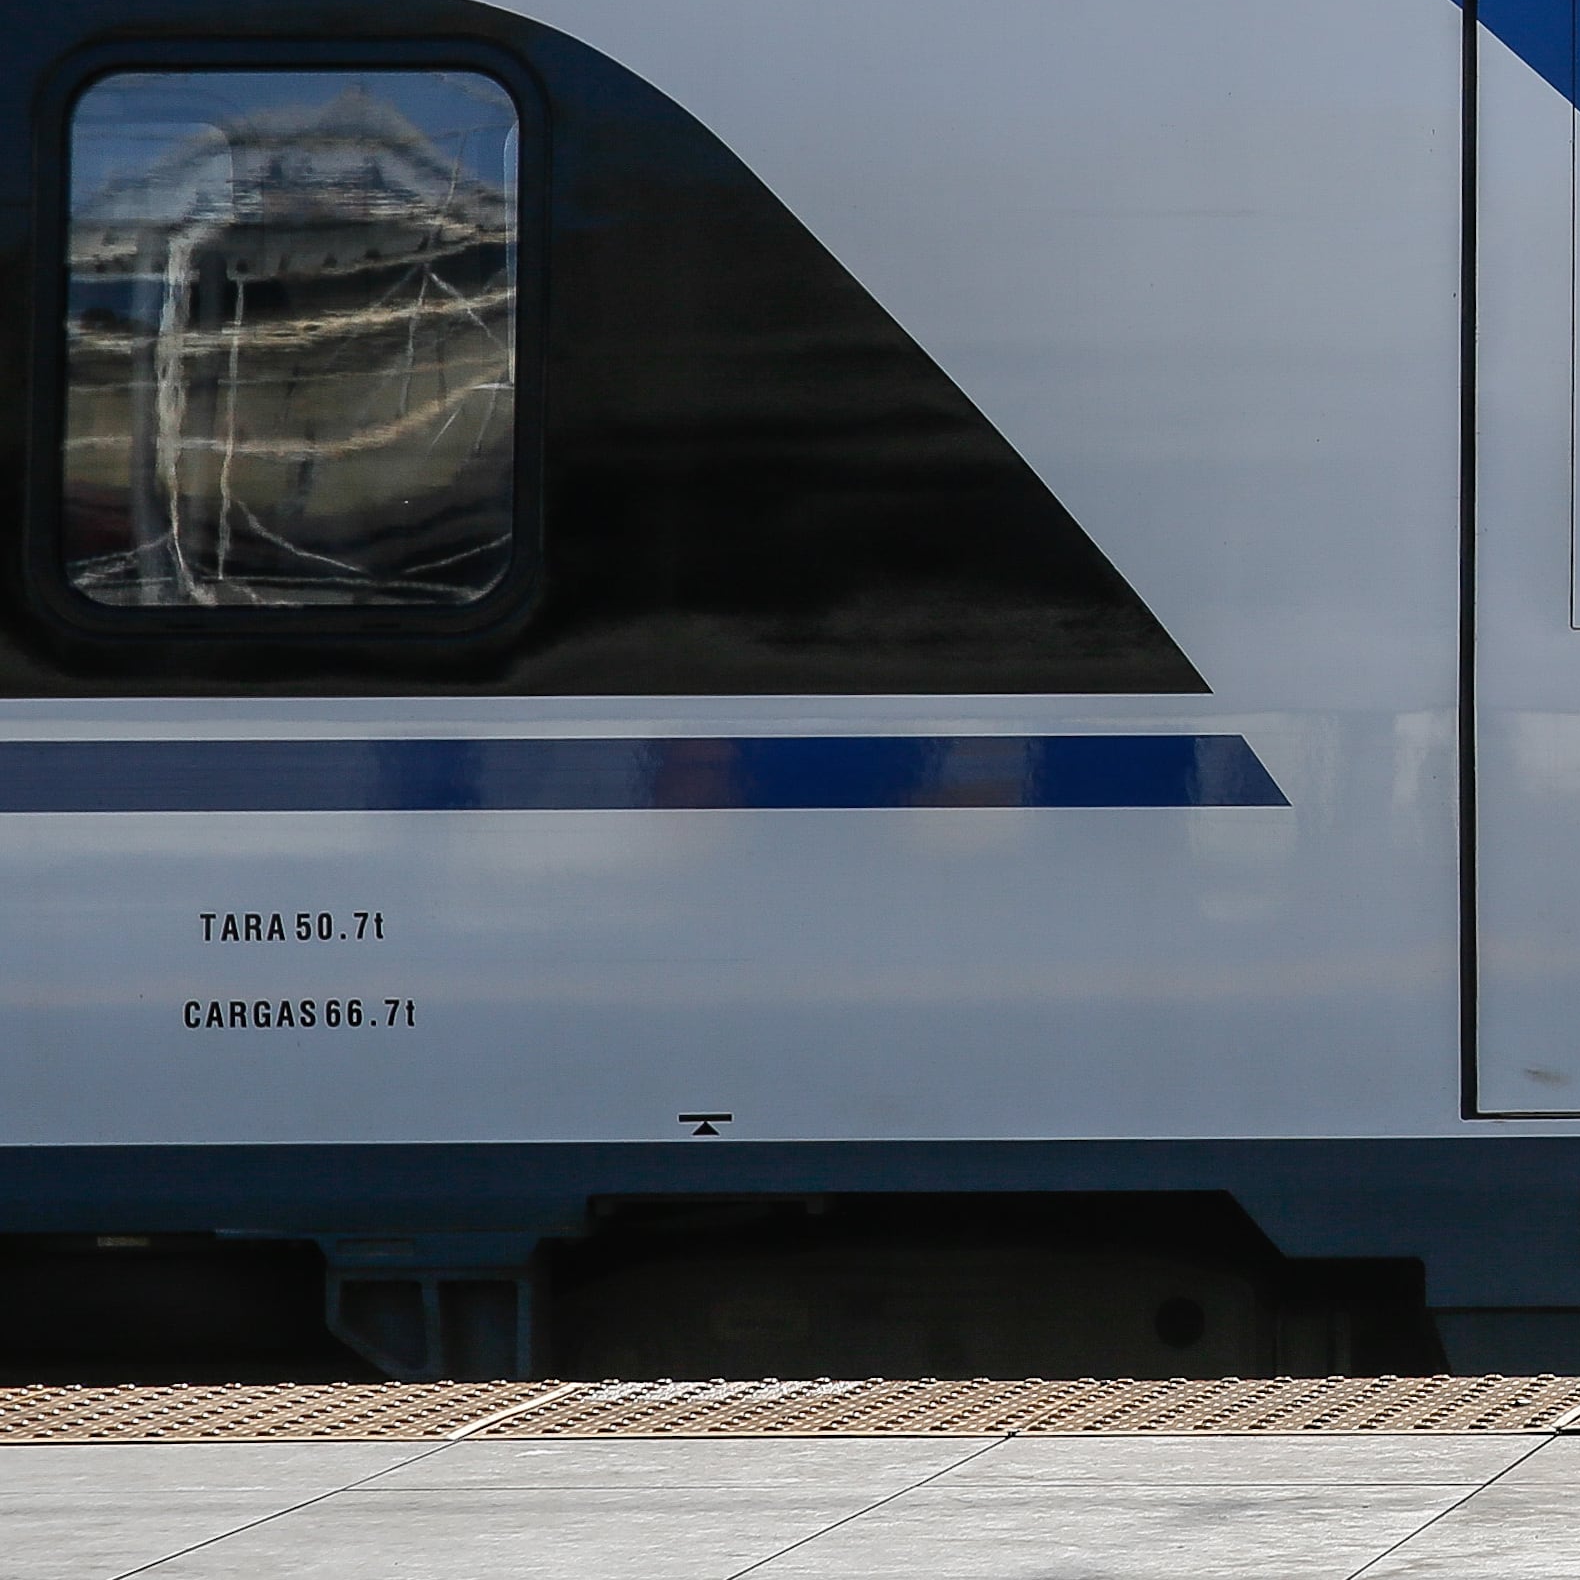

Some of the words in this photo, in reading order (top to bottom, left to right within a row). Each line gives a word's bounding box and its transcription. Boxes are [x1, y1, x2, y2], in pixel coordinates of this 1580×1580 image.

[199, 912, 286, 943] TARA
[295, 911, 385, 942] 50.7t
[183, 999, 317, 1030] CARGAS
[325, 998, 416, 1029] 66.7t
